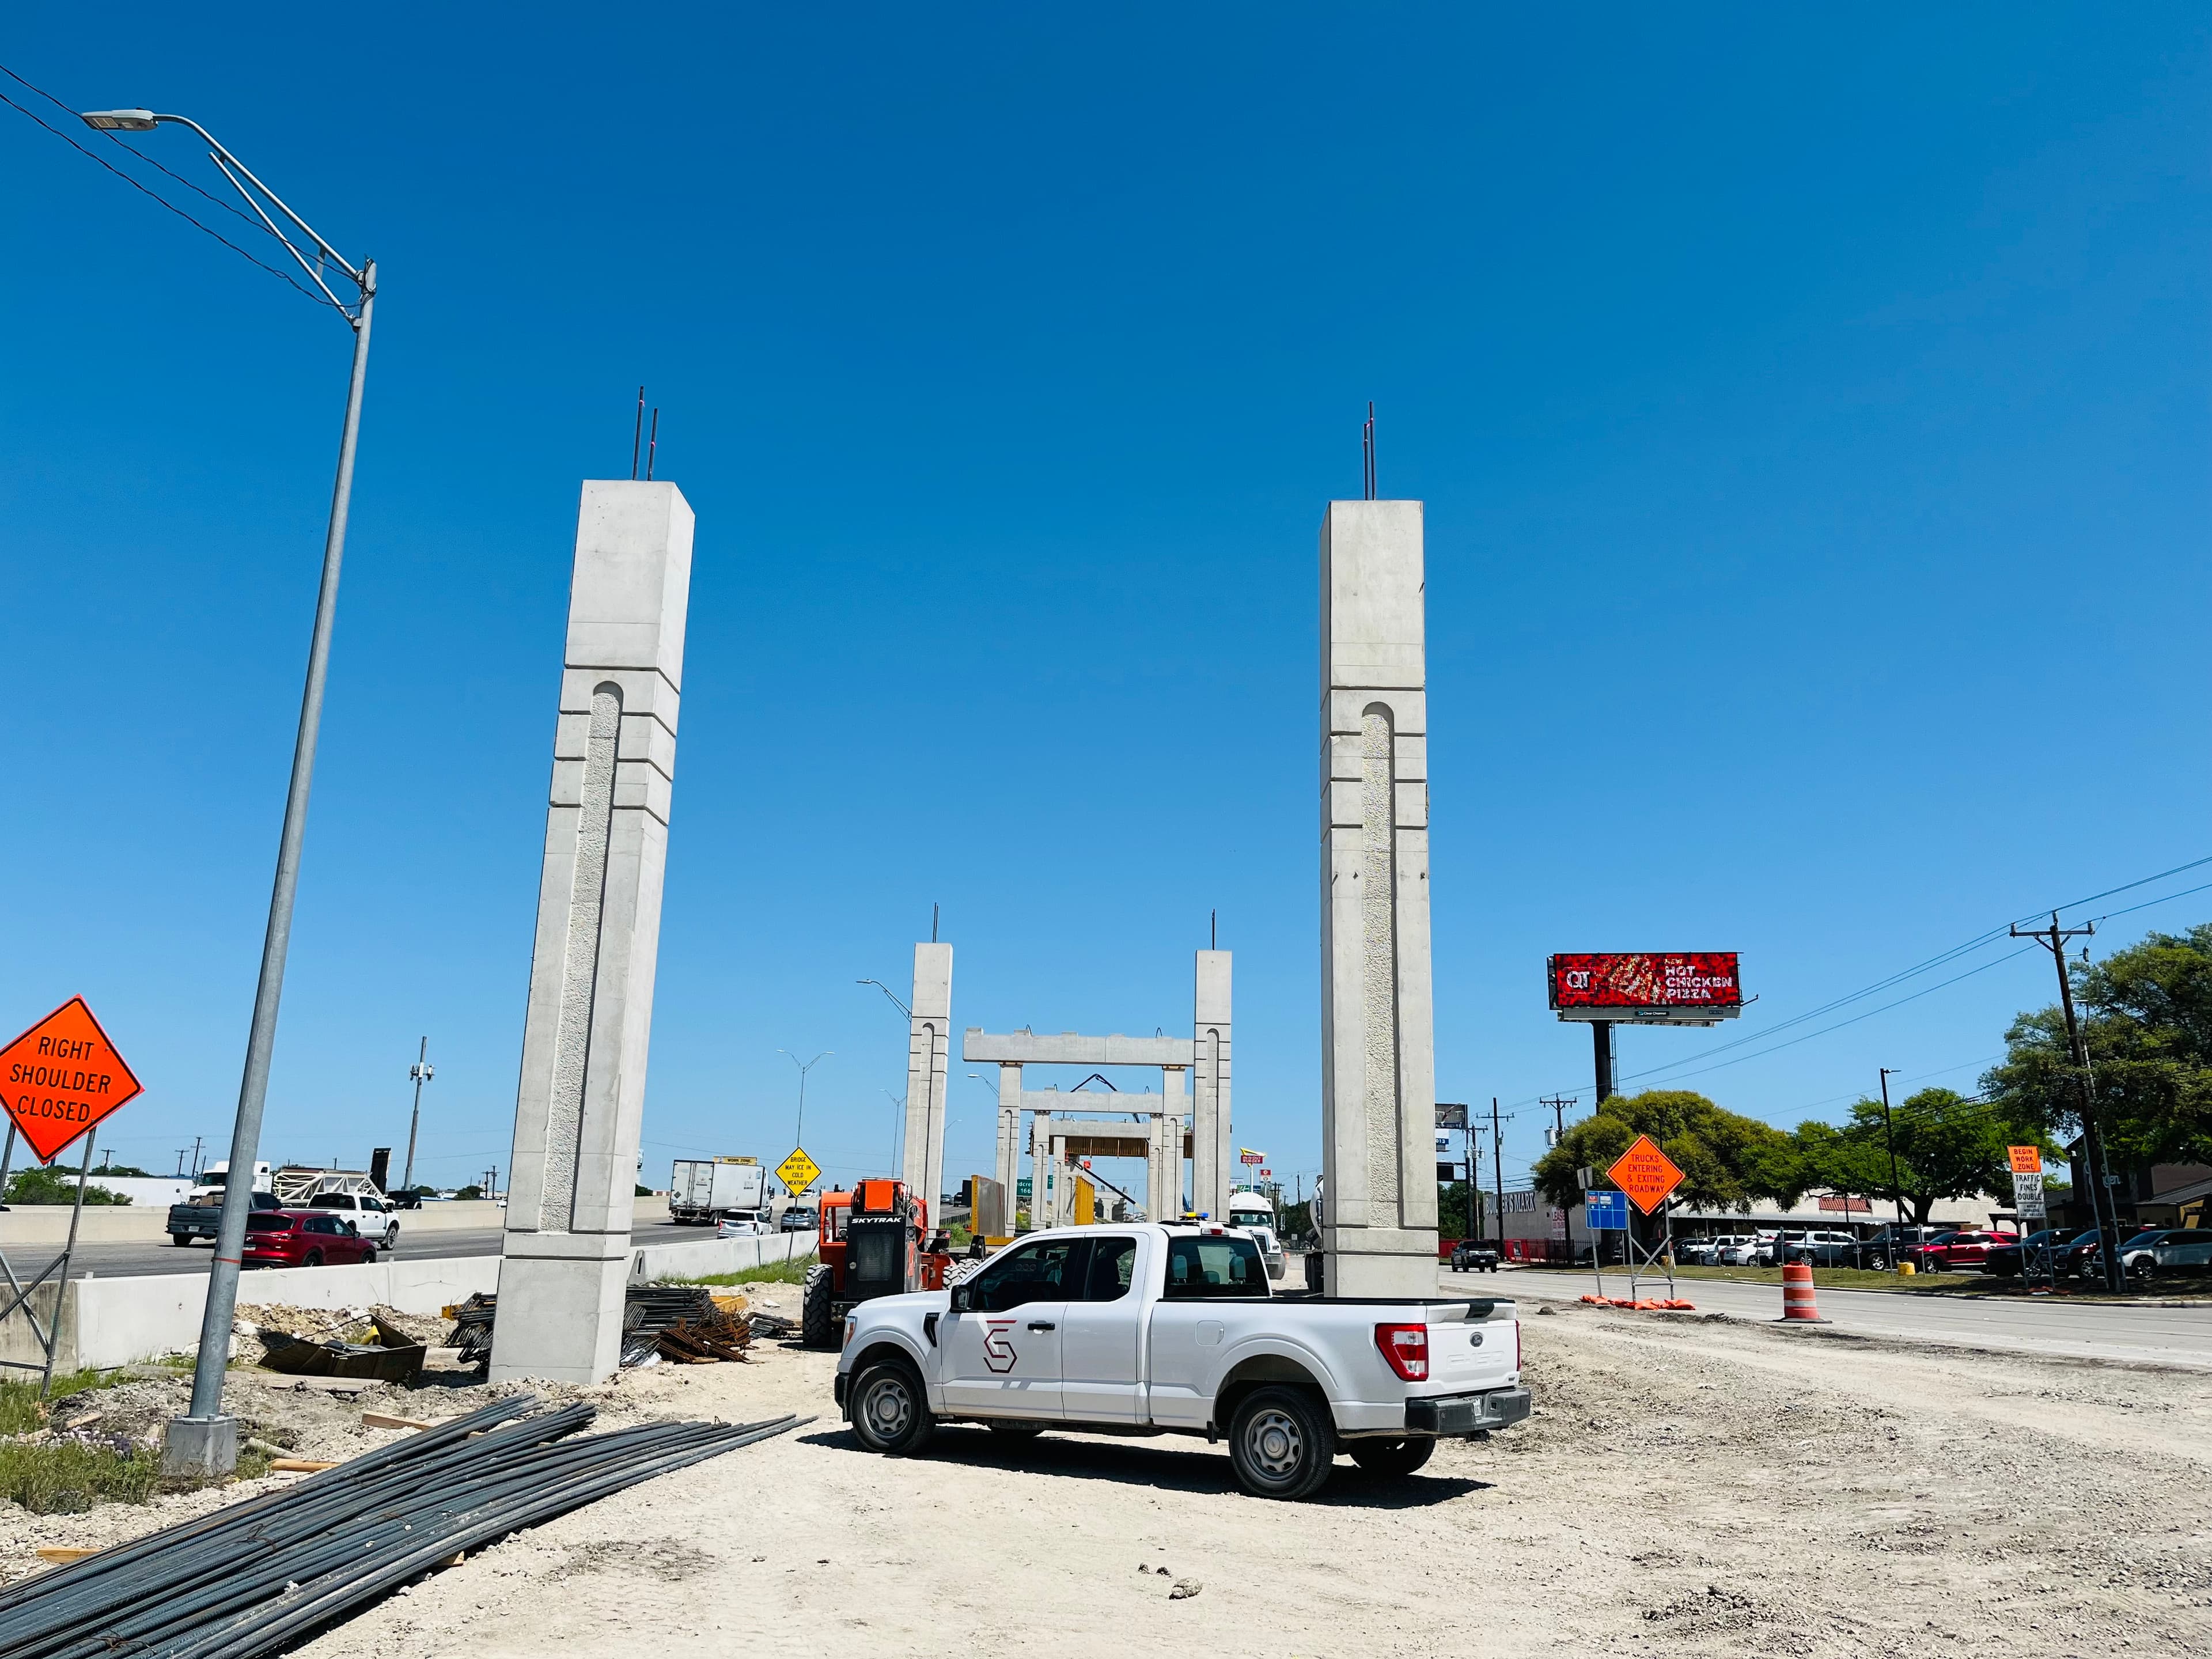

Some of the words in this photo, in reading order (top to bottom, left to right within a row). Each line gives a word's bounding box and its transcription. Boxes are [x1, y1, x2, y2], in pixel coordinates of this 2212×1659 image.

[1665, 966, 1696, 976] HOT
[1566, 971, 1590, 990] QT
[1665, 976, 1733, 988] CHICKEN
[1665, 988, 1711, 999] PIZZA
[37, 1036, 94, 1060] RIGHT
[9, 1063, 111, 1094] SHOULDER
[17, 1095, 90, 1122] CLOSED
[1631, 1154, 1659, 1162] TRUCKS
[1628, 1164, 1663, 1173] ENTERING
[1627, 1174, 1633, 1182] &
[1638, 1175, 1665, 1183] EXITING
[1629, 1184, 1665, 1193] ROADWAY
[1486, 1194, 1513, 1214] BUILER'S
[1514, 1192, 1535, 1212] MARK
